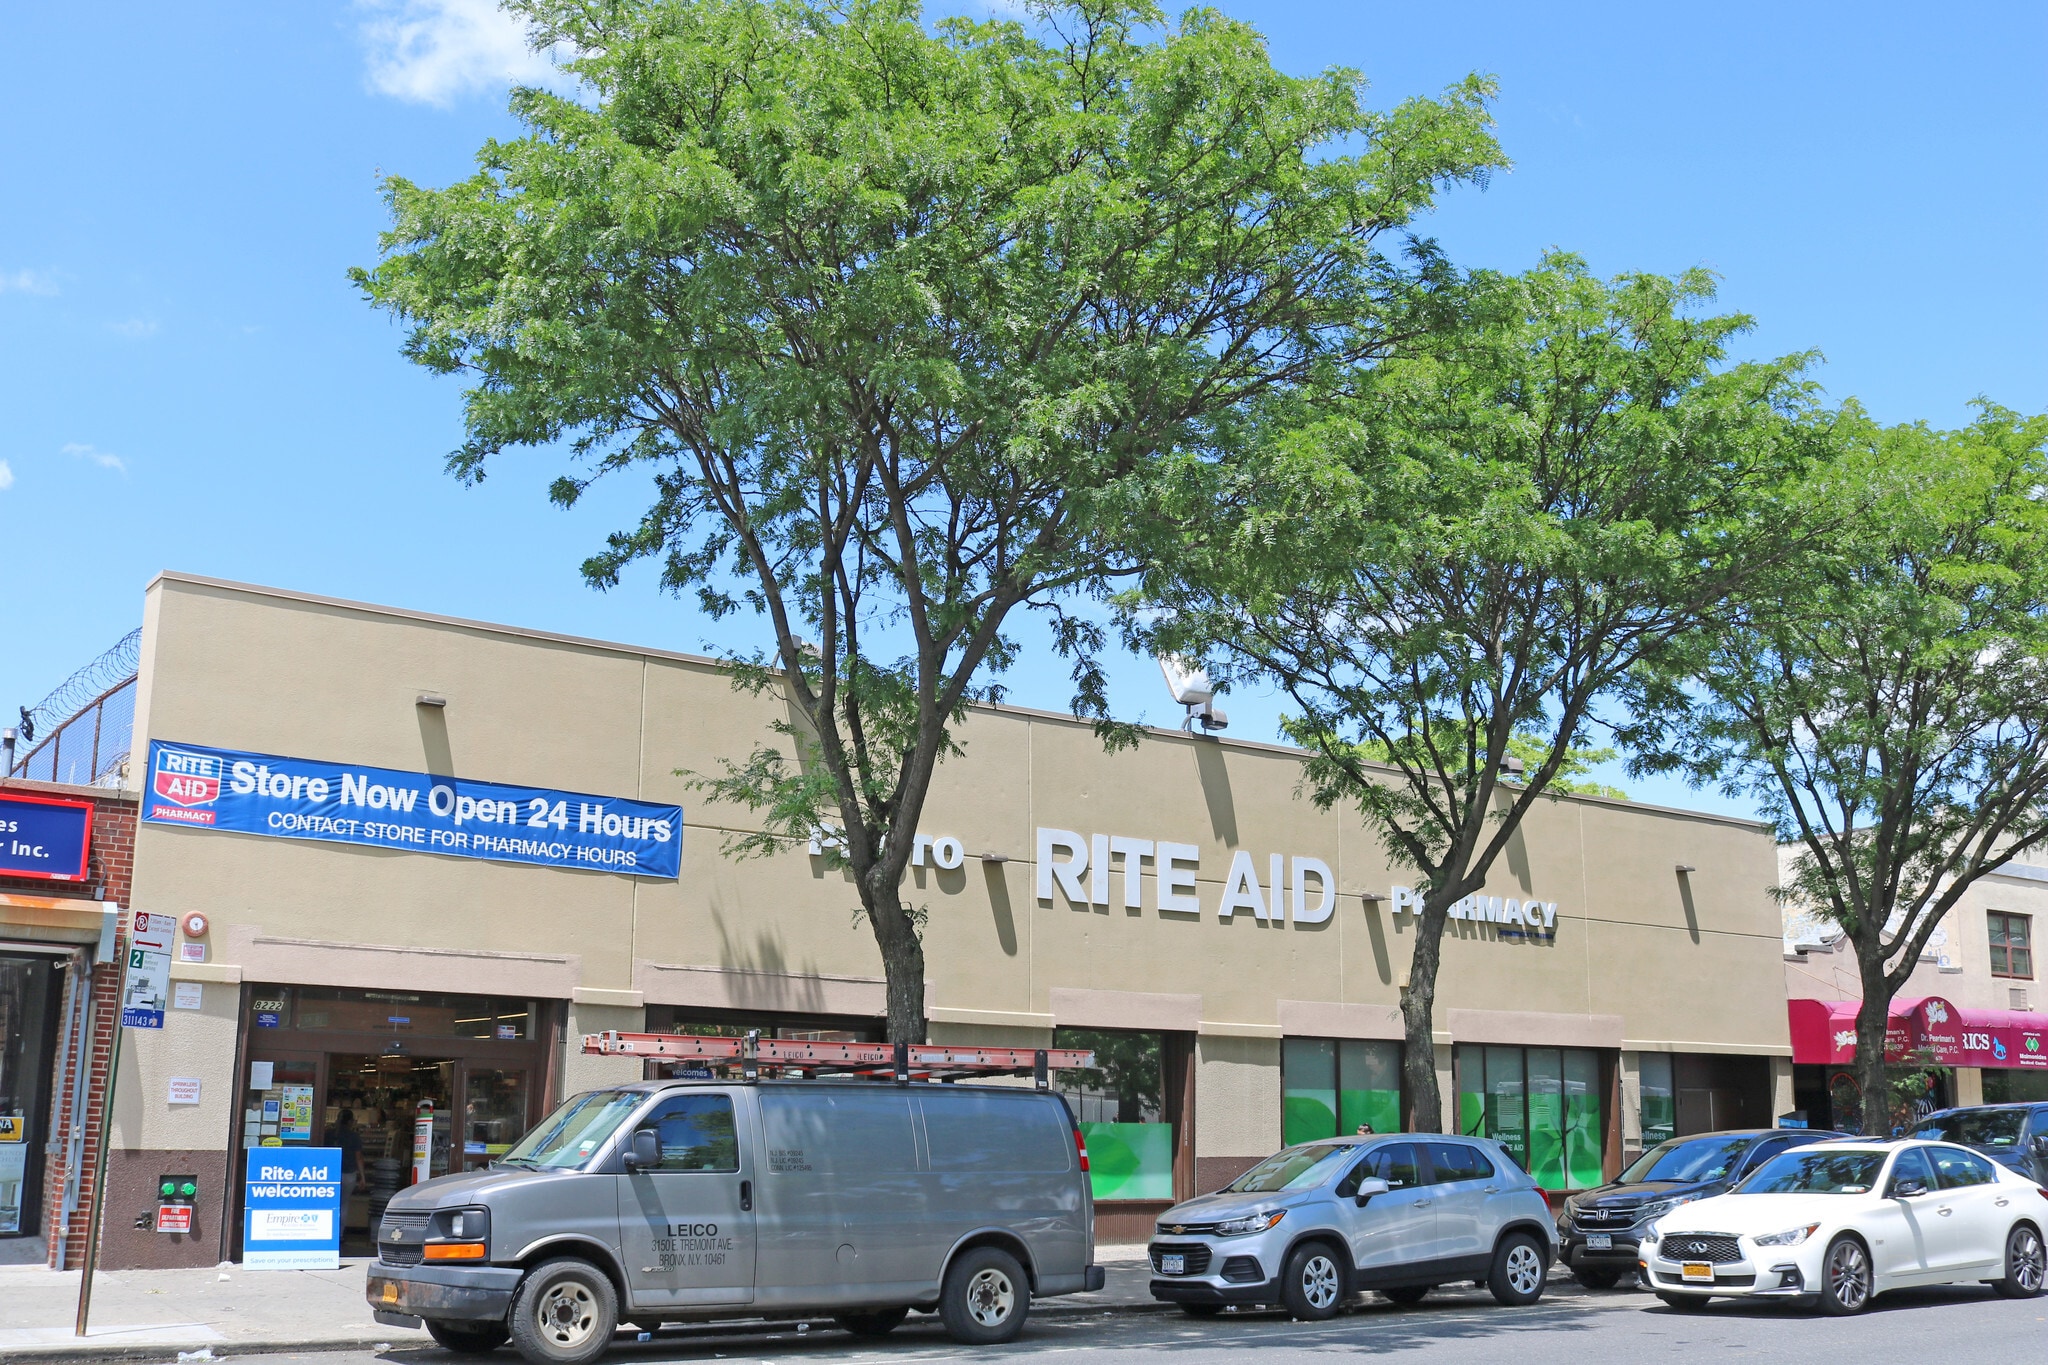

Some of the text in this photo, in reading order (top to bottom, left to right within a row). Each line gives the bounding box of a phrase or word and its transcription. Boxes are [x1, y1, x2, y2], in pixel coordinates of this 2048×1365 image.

[166, 754, 213, 775] RITE
[167, 778, 208, 798] AID
[230, 761, 672, 842] Store Now Open 24 Hours
[156, 808, 212, 822] PHARMACY
[268, 811, 637, 866] CONTACT STORE FOR PHARMACY HOURS
[12, 840, 49, 858] Inc.
[1037, 826, 1335, 923] RITE AID
[132, 951, 140, 967] 2
[255, 1001, 282, 1010] 8222
[123, 1015, 148, 1026] 311143
[1929, 1034, 1955, 1043] Pearlman's
[859, 1052, 880, 1060] LEICO
[1949, 1046, 1959, 1054] P.C.
[1492, 1133, 1521, 1141] Wellness
[261, 1166, 328, 1180] Rite Aid
[252, 1184, 335, 1198] welcomes
[266, 1213, 300, 1226] Empire
[668, 1224, 718, 1237] LEICO
[652, 1240, 670, 1251] 3150
[680, 1239, 716, 1250] TREMONT
[717, 1238, 733, 1250] AVE.
[688, 1254, 702, 1265] N.Y.
[705, 1253, 726, 1265] 10461
